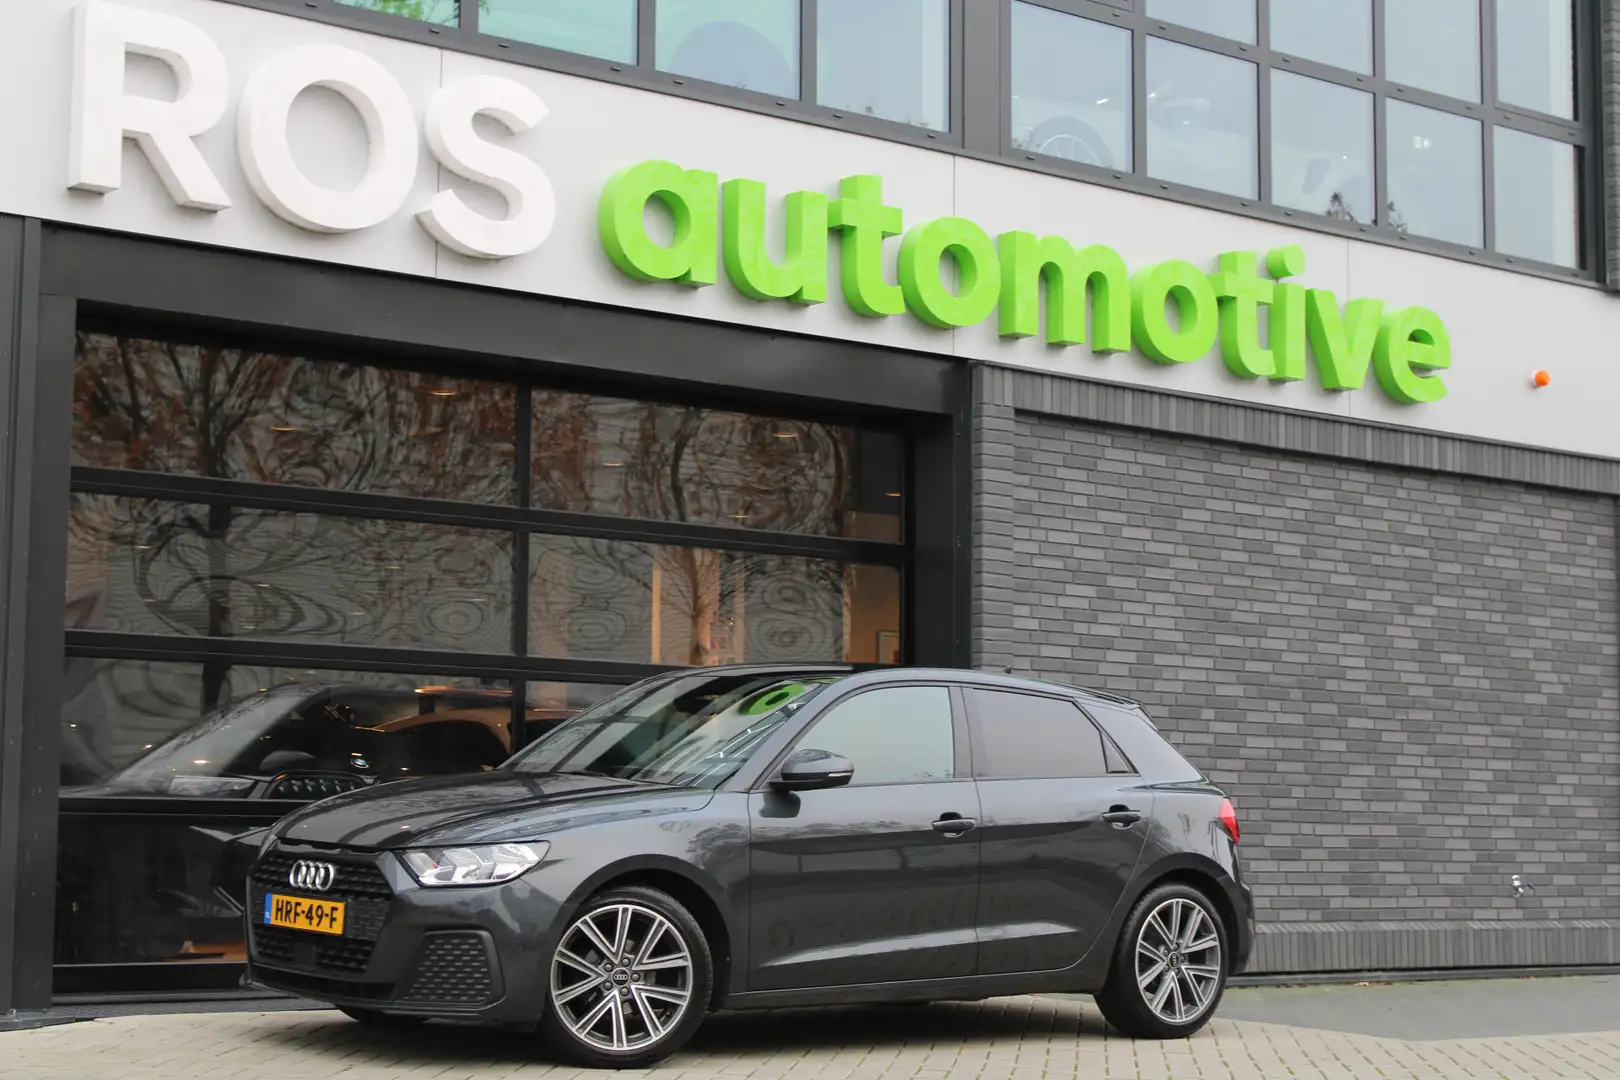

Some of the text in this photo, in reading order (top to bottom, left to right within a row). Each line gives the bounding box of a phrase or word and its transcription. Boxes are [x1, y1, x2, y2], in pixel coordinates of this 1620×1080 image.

[68, 0, 1451, 404] ROS automotive
[275, 899, 338, 928] HRF-49-F
